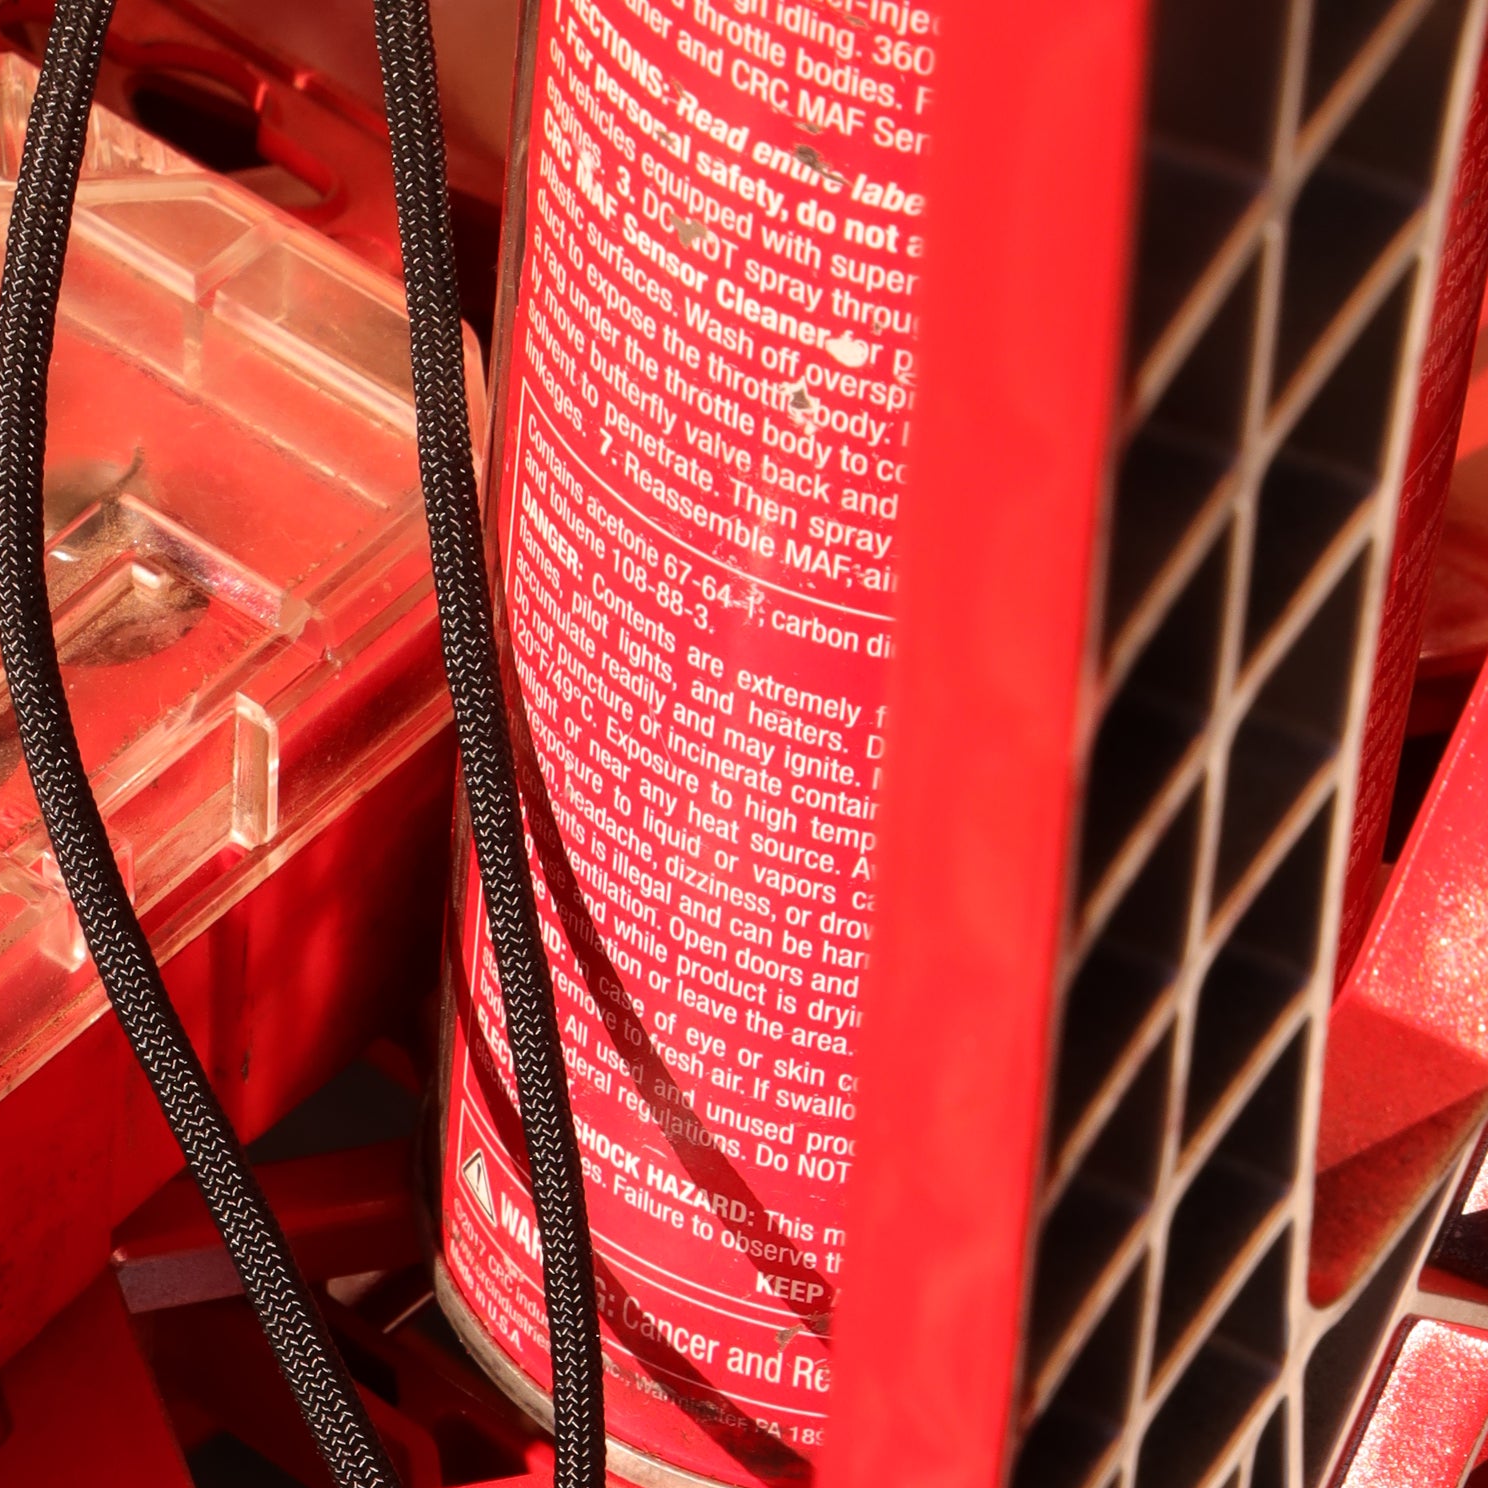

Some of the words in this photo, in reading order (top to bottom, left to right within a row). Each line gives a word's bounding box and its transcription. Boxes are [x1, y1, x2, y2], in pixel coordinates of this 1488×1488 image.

[677, 30, 724, 77] and
[731, 58, 789, 109] CRC
[797, 89, 866, 136] MAF
[693, 0, 786, 67] throttle
[796, 47, 903, 110] bodies.
[776, 0, 862, 60] idling.
[547, 76, 605, 175] engines.
[616, 165, 635, 203] 3.
[745, 259, 822, 312] spray
[550, 37, 565, 77] on
[569, 67, 636, 162] vehicles
[642, 153, 753, 240] equipped
[762, 225, 821, 270] with
[596, 64, 691, 163] personal
[696, 151, 788, 222] safety,
[796, 199, 836, 234] do
[844, 218, 900, 253] not
[677, 90, 749, 152] Read
[540, 150, 584, 230] plastic
[587, 221, 678, 318] surfaces.
[685, 297, 754, 359] Wash
[761, 345, 800, 378] off
[544, 108, 572, 171] CRC
[576, 157, 618, 221] MAF
[623, 212, 708, 293] Sensor
[716, 278, 831, 348] Cleaner
[537, 189, 565, 248] duct
[569, 233, 583, 270] to
[587, 263, 656, 340] expose
[663, 324, 700, 369] the
[813, 397, 891, 447] body.
[544, 242, 566, 295] rag
[569, 281, 620, 348] under
[625, 334, 658, 381] the
[665, 366, 754, 435] throttle
[762, 417, 832, 470] body
[840, 445, 868, 476] to
[525, 328, 587, 438] linkages.
[599, 428, 617, 466] 7.
[625, 451, 775, 558] Reassemble
[785, 538, 853, 588] MAF,
[529, 298, 577, 387] solvent
[581, 372, 599, 408] to
[605, 401, 720, 497] penetrate.
[730, 477, 797, 529] Then
[809, 515, 893, 559] spray
[545, 286, 584, 354] move
[590, 340, 677, 436] butterfly
[685, 421, 751, 473] valve
[762, 454, 830, 504] back
[841, 488, 899, 520] and
[522, 482, 583, 581] DANGER:
[593, 573, 675, 653] Contents
[687, 645, 724, 679] are
[737, 669, 861, 728] extremely
[525, 449, 547, 495] and
[550, 482, 605, 559] toluene
[613, 548, 714, 635] 108-88-3.
[528, 414, 583, 505] Contains
[587, 495, 659, 567] acetone
[771, 609, 859, 653] carbon
[514, 575, 530, 615] Do
[532, 613, 554, 651] not
[558, 644, 633, 722] puncture
[640, 714, 661, 739] or
[668, 727, 782, 796] incinerate
[516, 551, 595, 659] accumulate
[602, 651, 667, 715] readily
[673, 702, 715, 739] and
[724, 727, 775, 767] may
[784, 744, 861, 787] ignite.
[519, 515, 563, 599] flames,
[572, 591, 609, 639] pilot
[618, 628, 677, 691] lights,
[691, 680, 734, 715] and
[749, 701, 848, 753] heaters.
[565, 716, 582, 742] or
[589, 740, 631, 783] near
[640, 778, 677, 816] any
[688, 800, 739, 844] heat
[750, 831, 841, 875] source.
[565, 772, 658, 870] headache,
[665, 856, 776, 923] dizziness,
[786, 906, 812, 928] or
[606, 716, 698, 793] Exposure
[711, 780, 733, 809] to
[745, 794, 797, 832] high
[614, 786, 632, 817] to
[643, 807, 701, 858] liquid
[715, 850, 739, 873] or
[753, 863, 836, 904] vapors
[550, 892, 642, 980] ventilation
[648, 969, 672, 994] or
[676, 980, 737, 1025] leave
[745, 1008, 784, 1041] the
[792, 1027, 854, 1057] area.
[563, 840, 662, 931] ventilation.
[669, 915, 727, 961] Open
[735, 947, 804, 987] doors
[811, 971, 859, 999] and
[573, 884, 607, 924] and
[613, 915, 668, 964] while
[676, 953, 767, 1006] product
[776, 988, 797, 1014] is
[591, 832, 607, 862] is
[612, 848, 672, 905] illegal
[679, 893, 722, 929] and
[729, 916, 772, 948] can
[782, 930, 812, 959] be
[551, 964, 617, 1030] remove
[623, 1017, 642, 1046] to
[650, 1033, 704, 1079] fresh
[711, 1066, 745, 1096] air.
[753, 1078, 770, 1101] If
[565, 1016, 588, 1047] All
[597, 1041, 644, 1085] used
[654, 1078, 695, 1108] and
[706, 1101, 795, 1145] unused
[600, 976, 645, 1018] case
[654, 1011, 677, 1035] of
[686, 1027, 727, 1058] eye
[737, 1047, 764, 1070] or
[773, 1057, 825, 1087] skin
[574, 1115, 640, 1180] SHOCK
[646, 1164, 755, 1227] HAZARD:
[763, 1209, 815, 1242] This
[618, 1086, 746, 1161] regulations.
[755, 1143, 789, 1172] Do
[797, 1154, 852, 1184] NOT
[613, 1176, 684, 1229] Failure
[692, 1214, 714, 1241] to
[721, 1229, 817, 1270] observe
[755, 1271, 824, 1305] KEEP
[622, 1296, 719, 1364] Cancer
[727, 1346, 782, 1384] and
